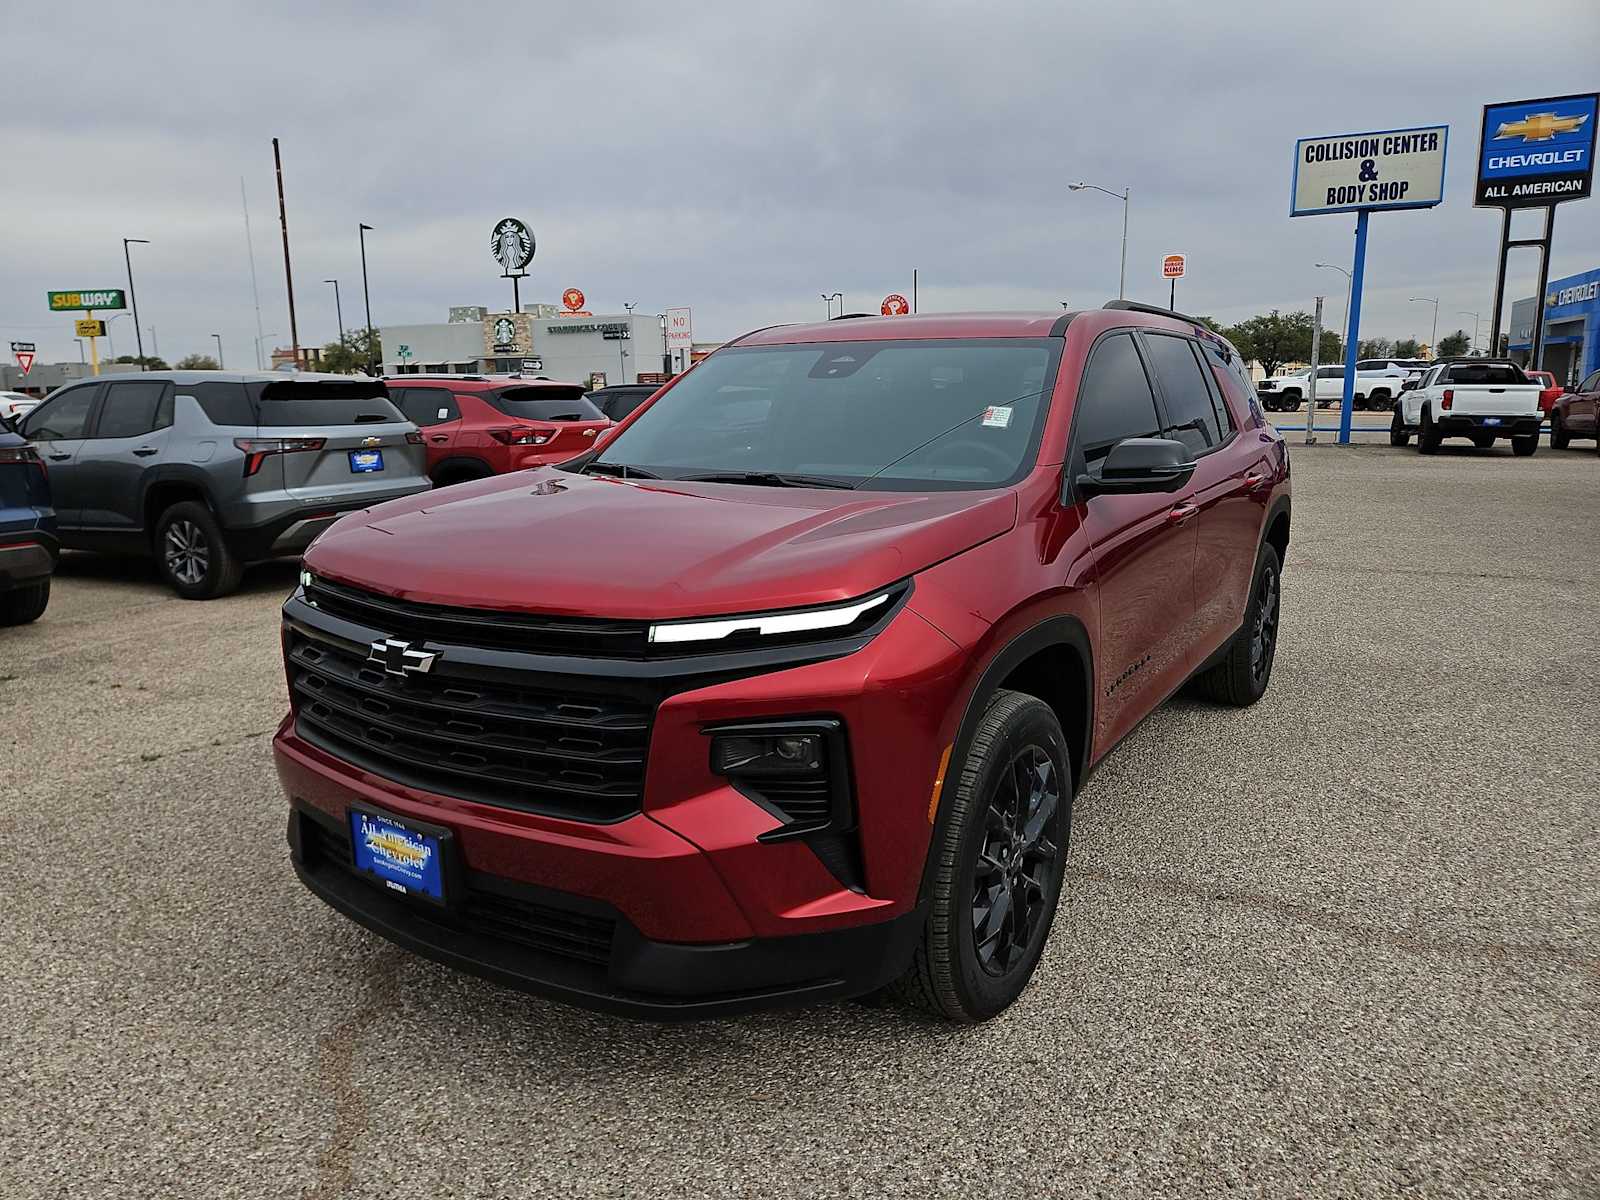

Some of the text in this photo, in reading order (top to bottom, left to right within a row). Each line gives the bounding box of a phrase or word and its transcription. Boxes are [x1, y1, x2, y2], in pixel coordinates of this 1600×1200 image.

[1305, 132, 1439, 163] COLLISION CENTER
[1359, 159, 1379, 182] &
[1488, 150, 1585, 169] CHEVROLET
[1326, 181, 1409, 206] BODY SHOP
[1485, 180, 1583, 198] ALL AMERICAN
[52, 292, 117, 307] SUBWAY
[1559, 281, 1599, 306] CHEVROLET
[673, 318, 685, 327] NO
[668, 331, 691, 340] PARKING
[361, 822, 432, 857] All American
[369, 841, 425, 870] Chevrolet
